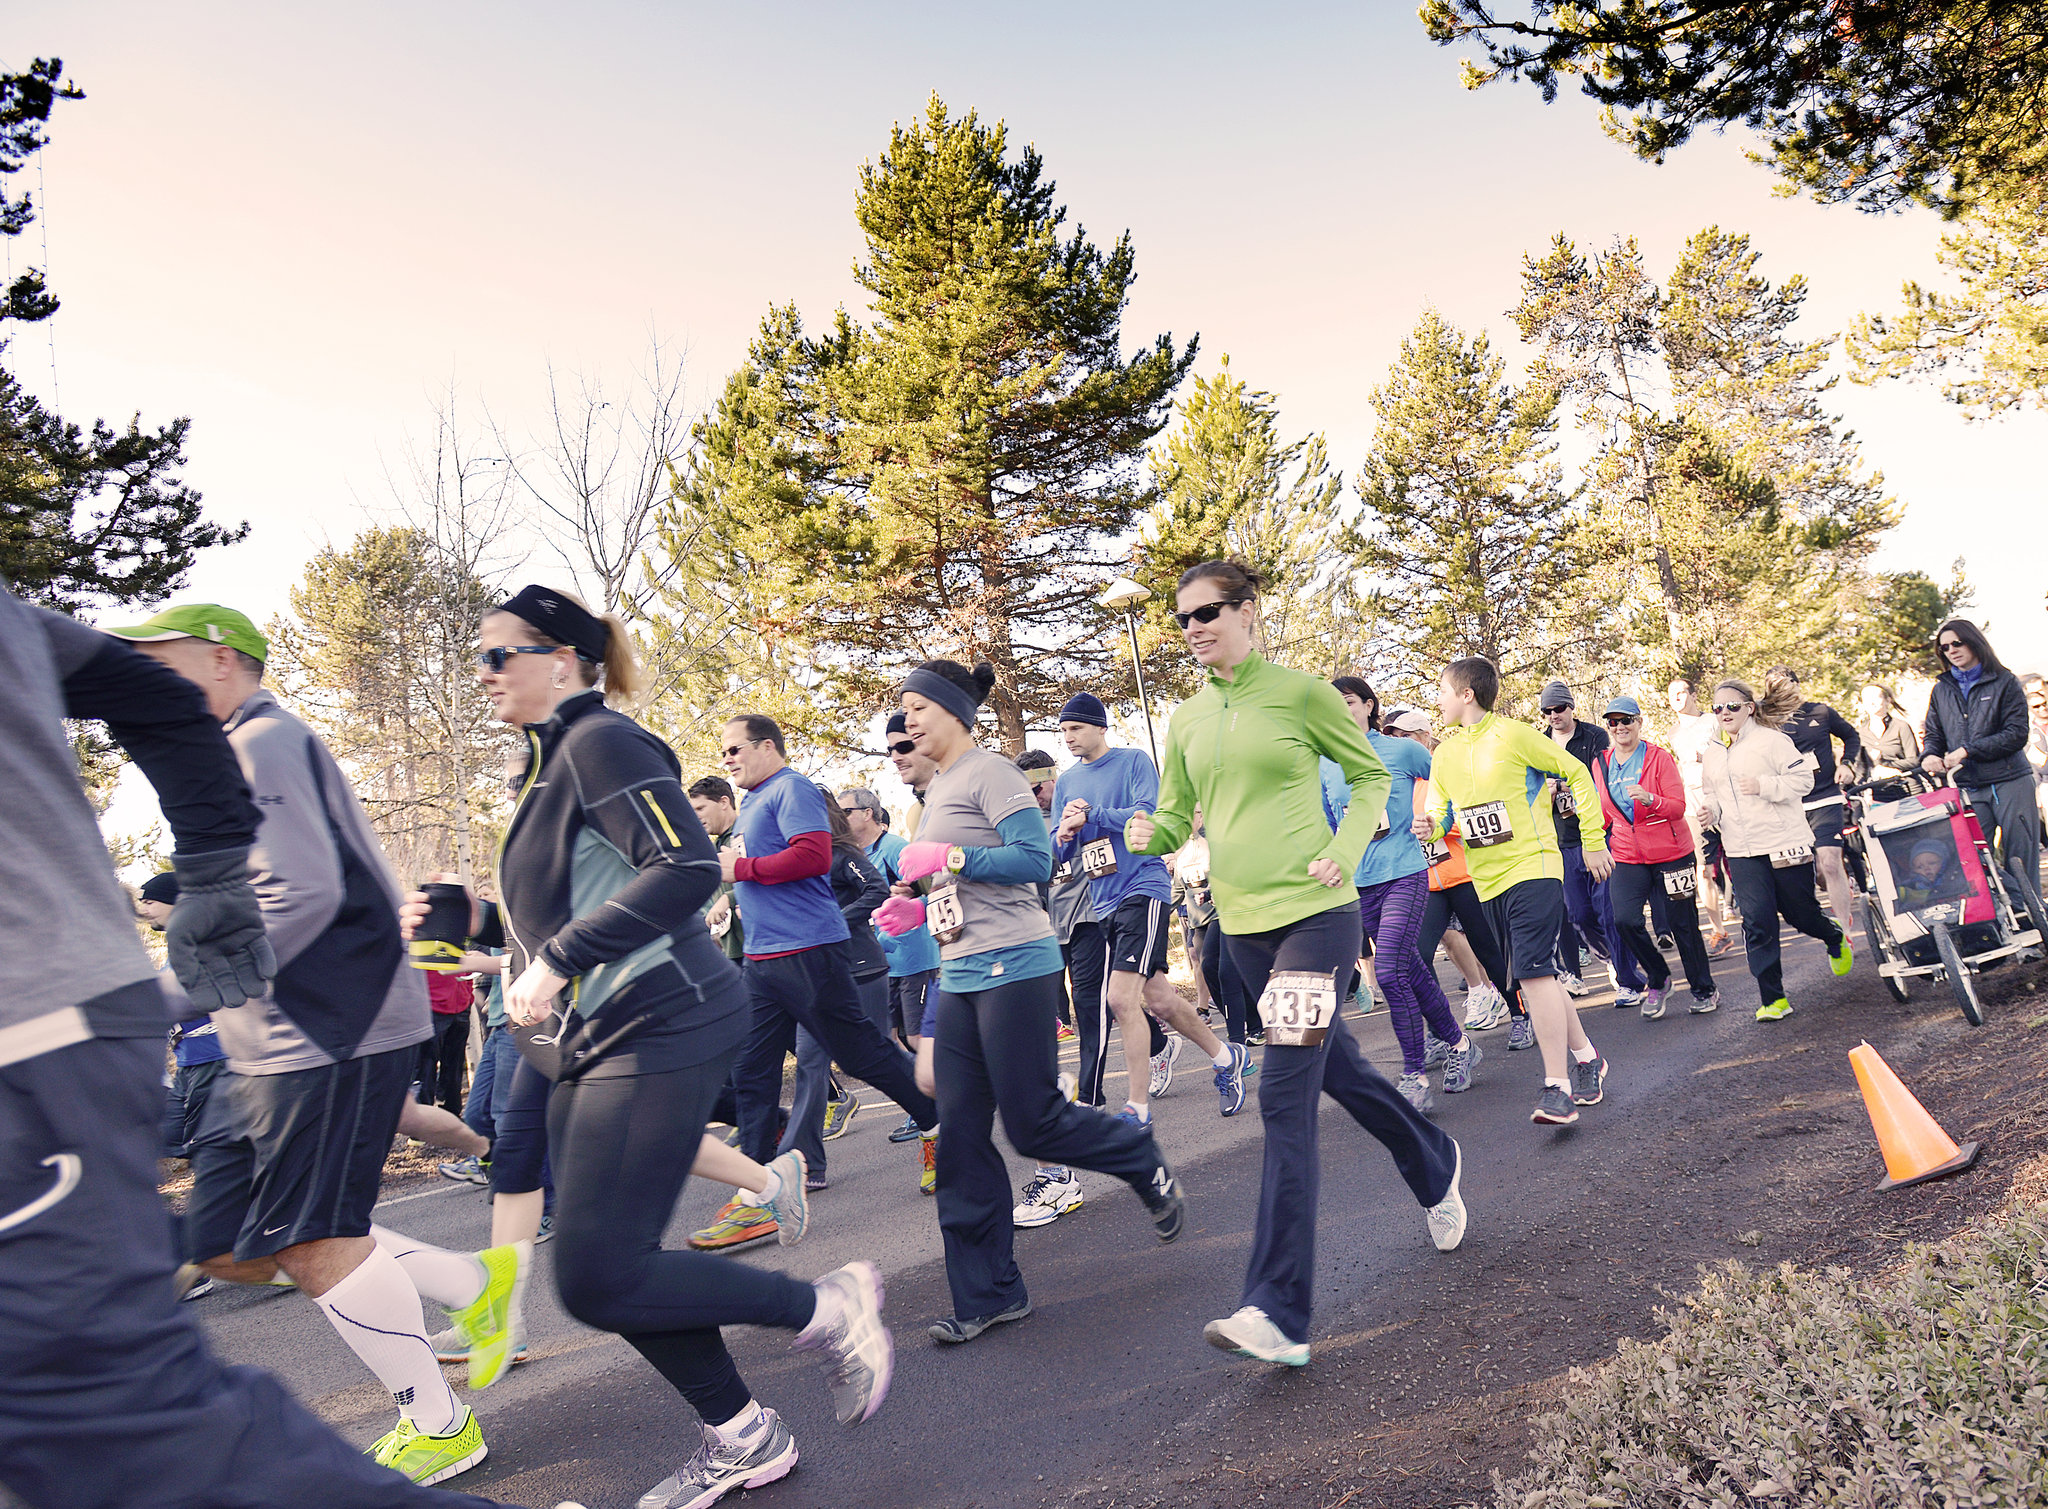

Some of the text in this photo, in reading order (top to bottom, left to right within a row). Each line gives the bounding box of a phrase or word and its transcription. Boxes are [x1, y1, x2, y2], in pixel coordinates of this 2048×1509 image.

[1467, 813, 1502, 837] 199
[1085, 848, 1106, 870] 125
[1267, 991, 1321, 1026] 335
